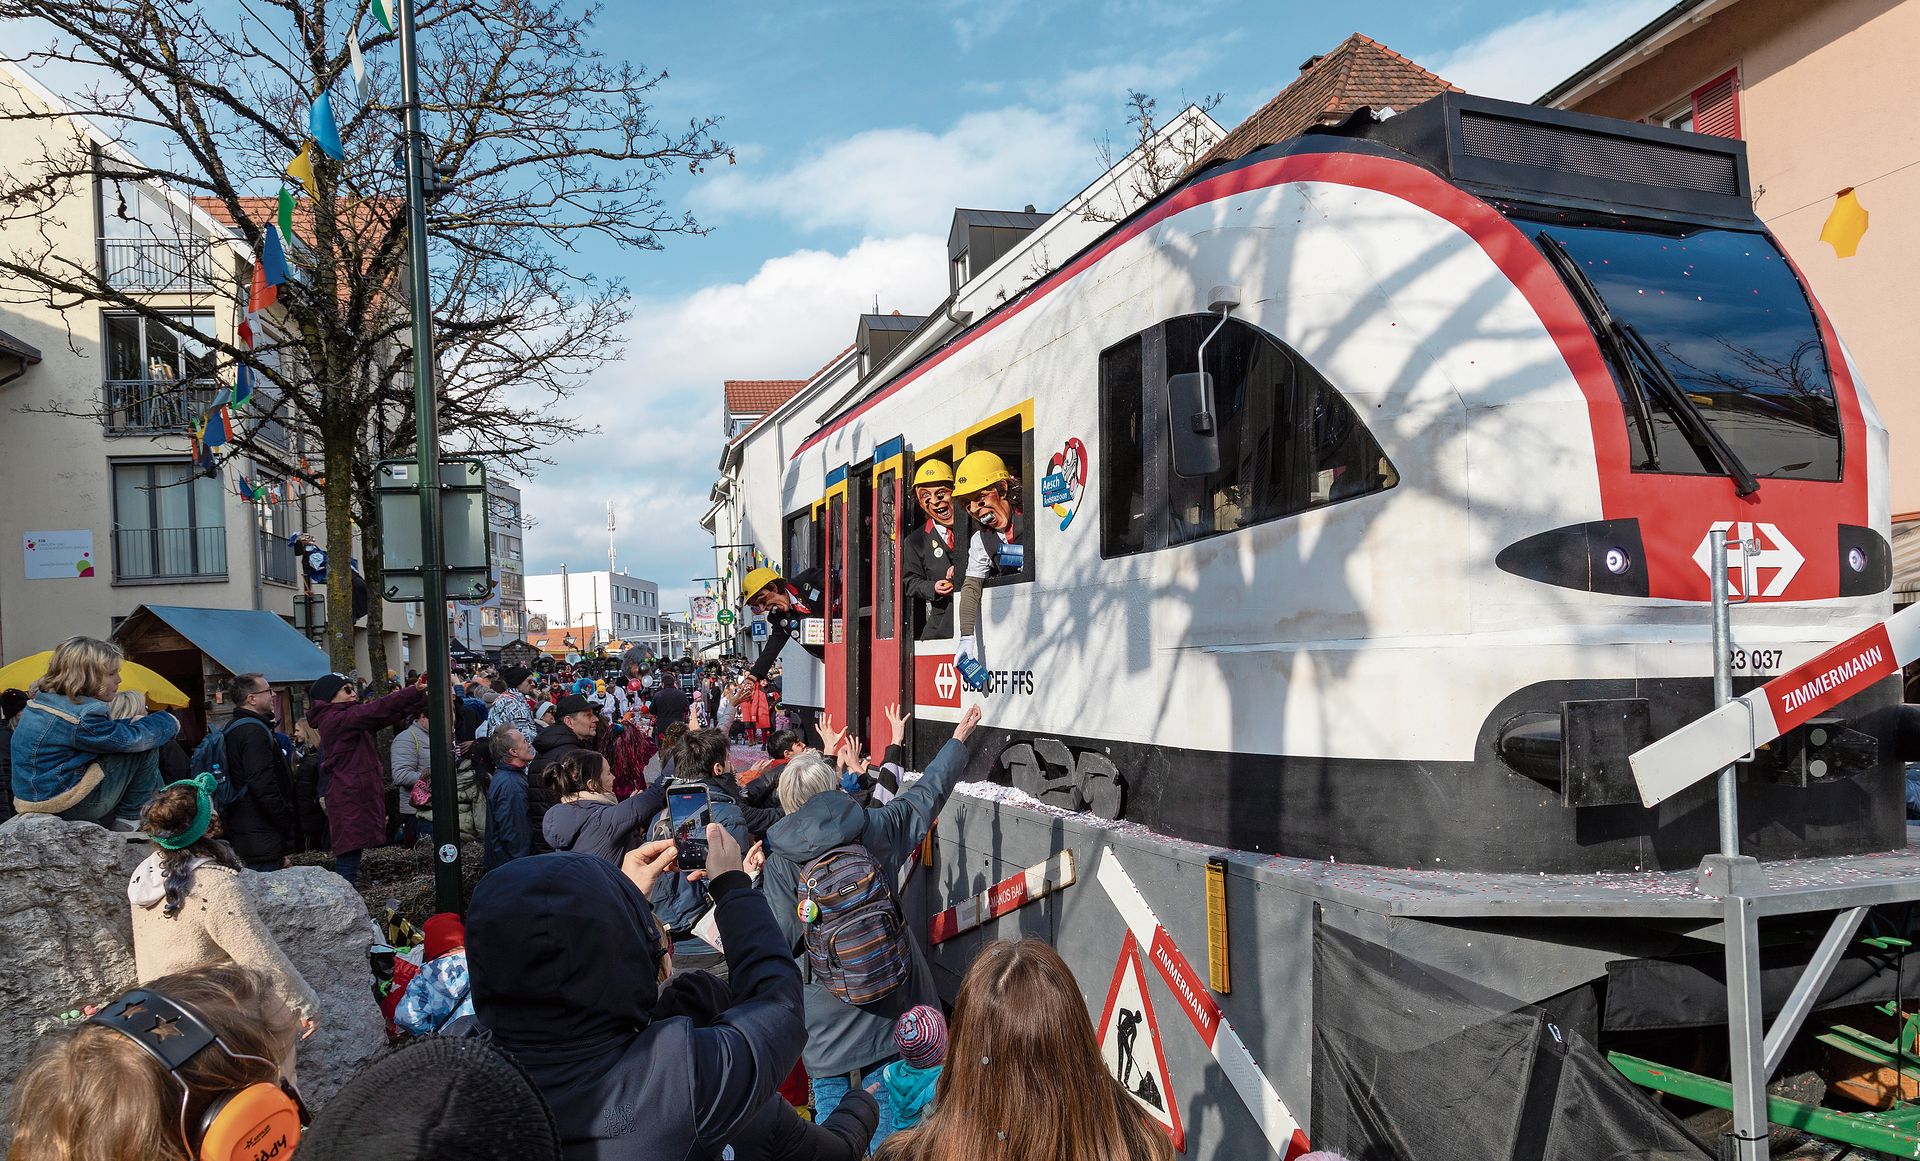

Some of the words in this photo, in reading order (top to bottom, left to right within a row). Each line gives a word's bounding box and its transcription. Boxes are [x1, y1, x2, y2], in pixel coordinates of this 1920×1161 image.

[1042, 477, 1060, 492] Aesch
[754, 623, 762, 634] P
[1752, 650, 1783, 669] 037
[986, 670, 1008, 694] CFF
[1011, 670, 1034, 696] FFS
[1781, 645, 1883, 714] ZIMMERMANN
[1011, 881, 1024, 899] BAU
[1156, 944, 1210, 1029] ZIMMERMANN
